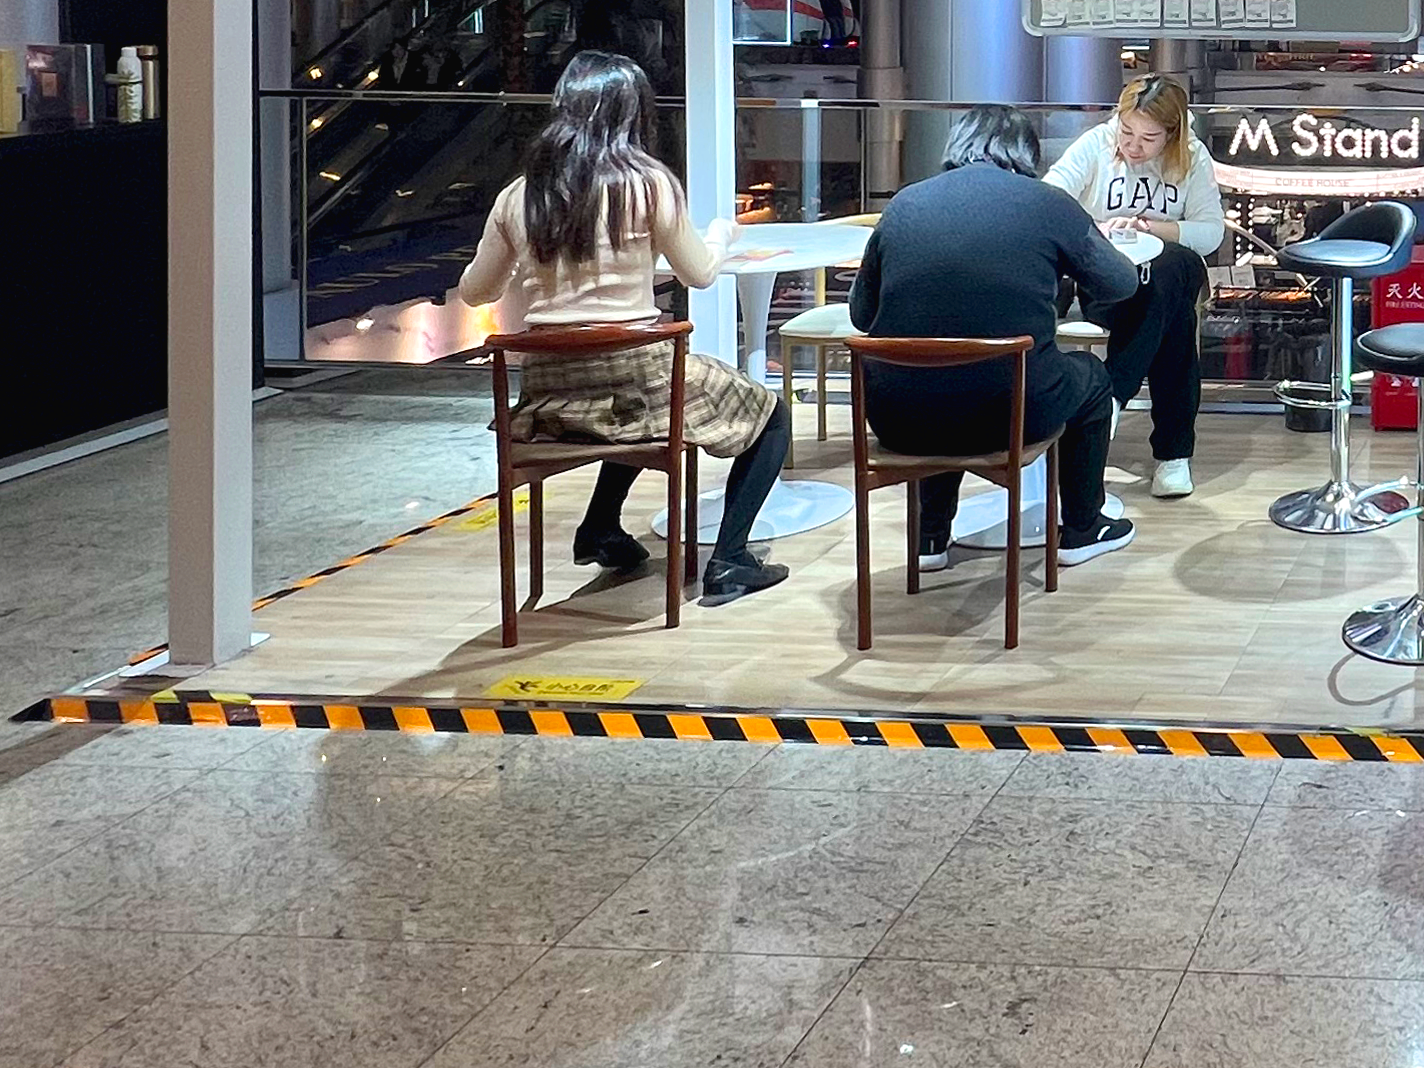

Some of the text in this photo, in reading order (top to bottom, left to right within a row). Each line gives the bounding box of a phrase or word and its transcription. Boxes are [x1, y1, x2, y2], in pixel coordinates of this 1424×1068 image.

[1229, 113, 1420, 159] M Stand
[1106, 177, 1178, 215] GAP
[1275, 177, 1313, 188] COFFEE
